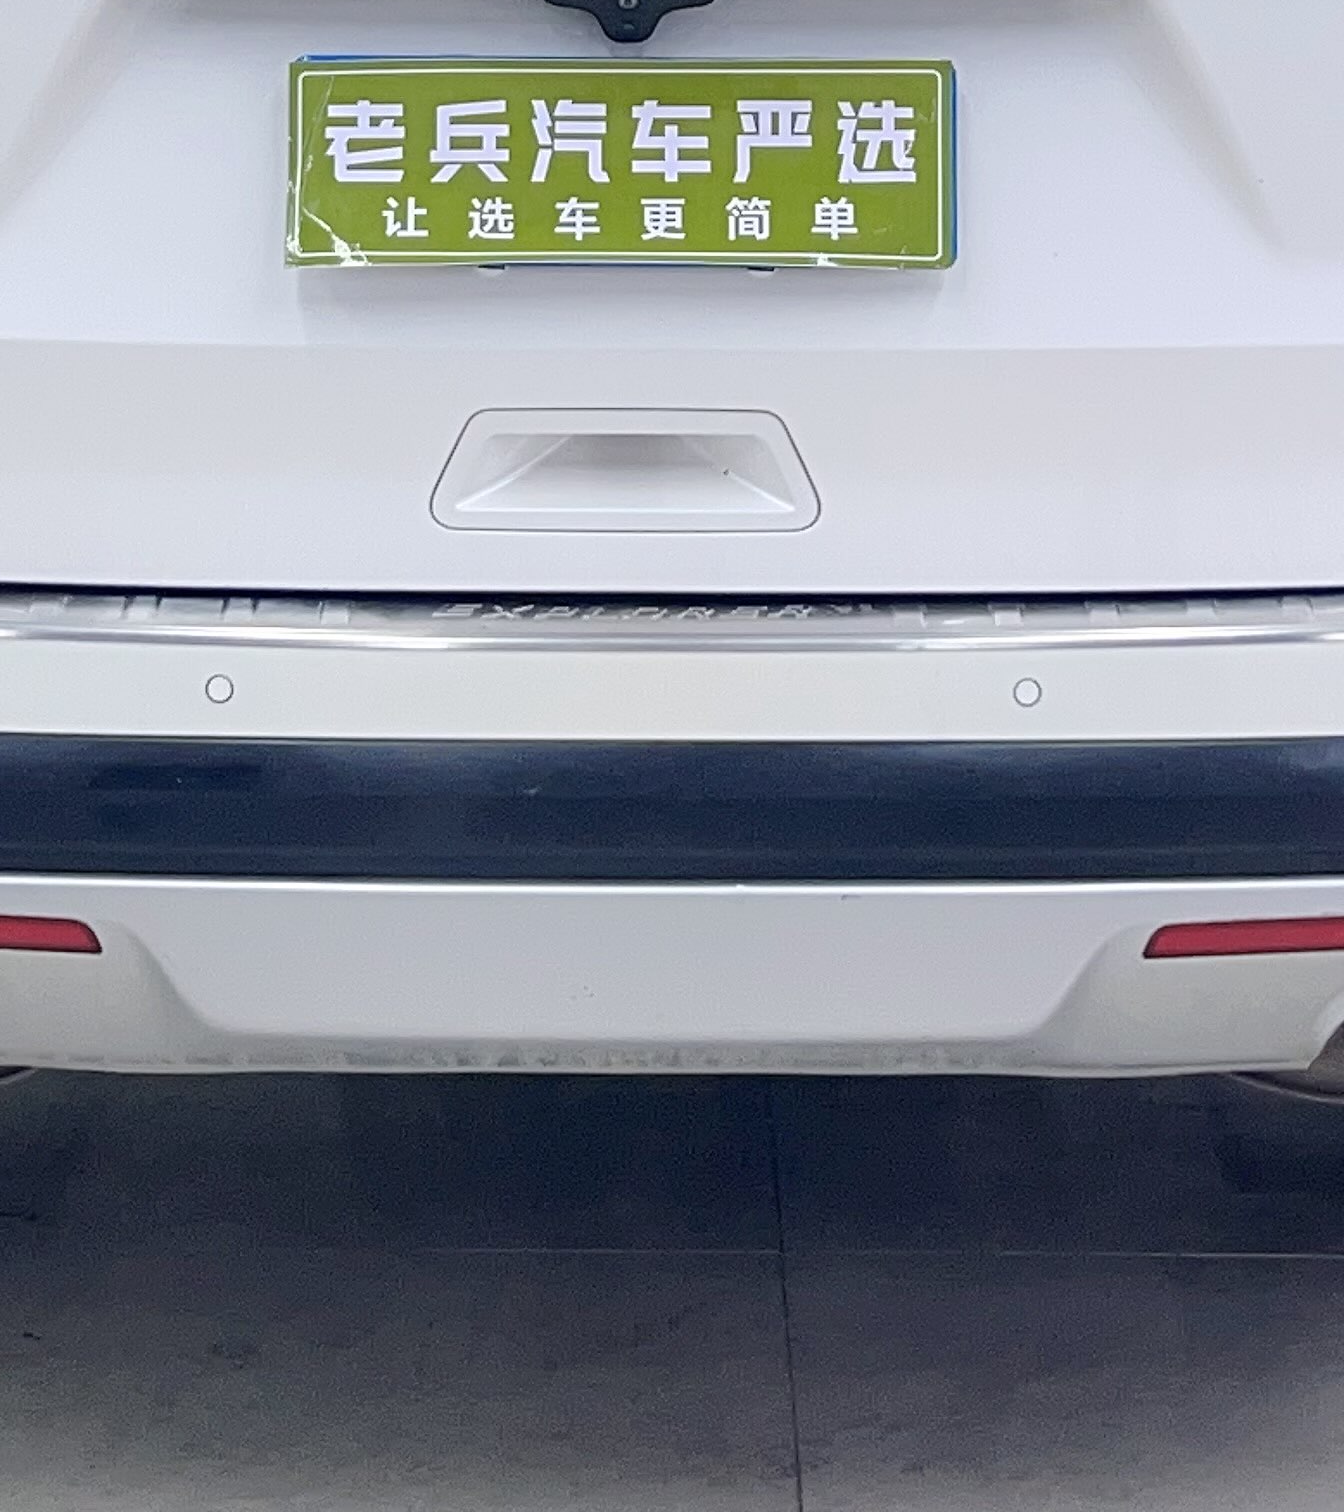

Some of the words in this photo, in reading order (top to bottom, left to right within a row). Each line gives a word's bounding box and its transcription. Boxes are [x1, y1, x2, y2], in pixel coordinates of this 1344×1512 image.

[324, 99, 919, 184] 老兵汽车严选
[382, 196, 859, 242] 让选车更简单
